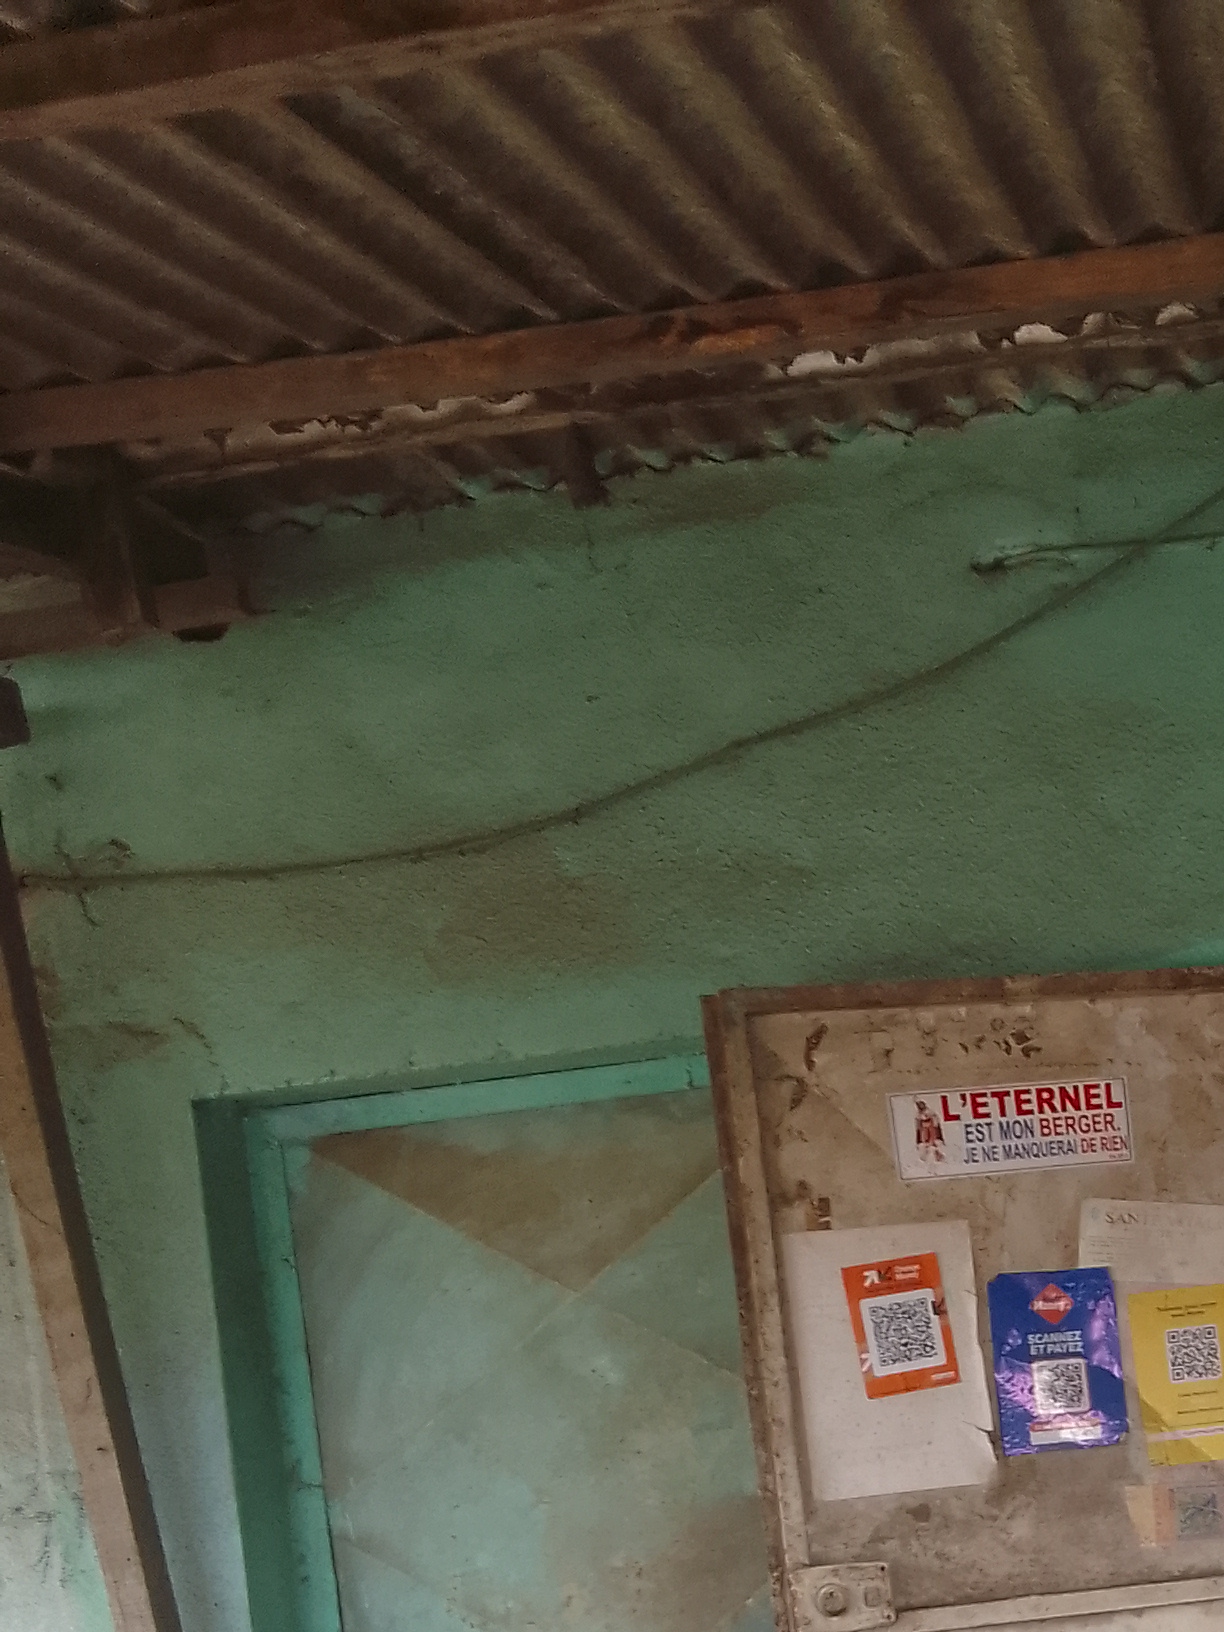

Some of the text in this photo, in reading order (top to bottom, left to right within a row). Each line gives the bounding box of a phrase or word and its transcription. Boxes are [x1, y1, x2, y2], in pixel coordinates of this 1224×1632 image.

[941, 1082, 1123, 1122] L'ETERNEL
[964, 1113, 1122, 1144] EST MON BERGER.
[963, 1135, 1128, 1164] JE NE MANQUERAI DE RIEN
[1027, 1330, 1083, 1345] SCANNEZ
[1030, 1341, 1084, 1356] ET PAYEZ
